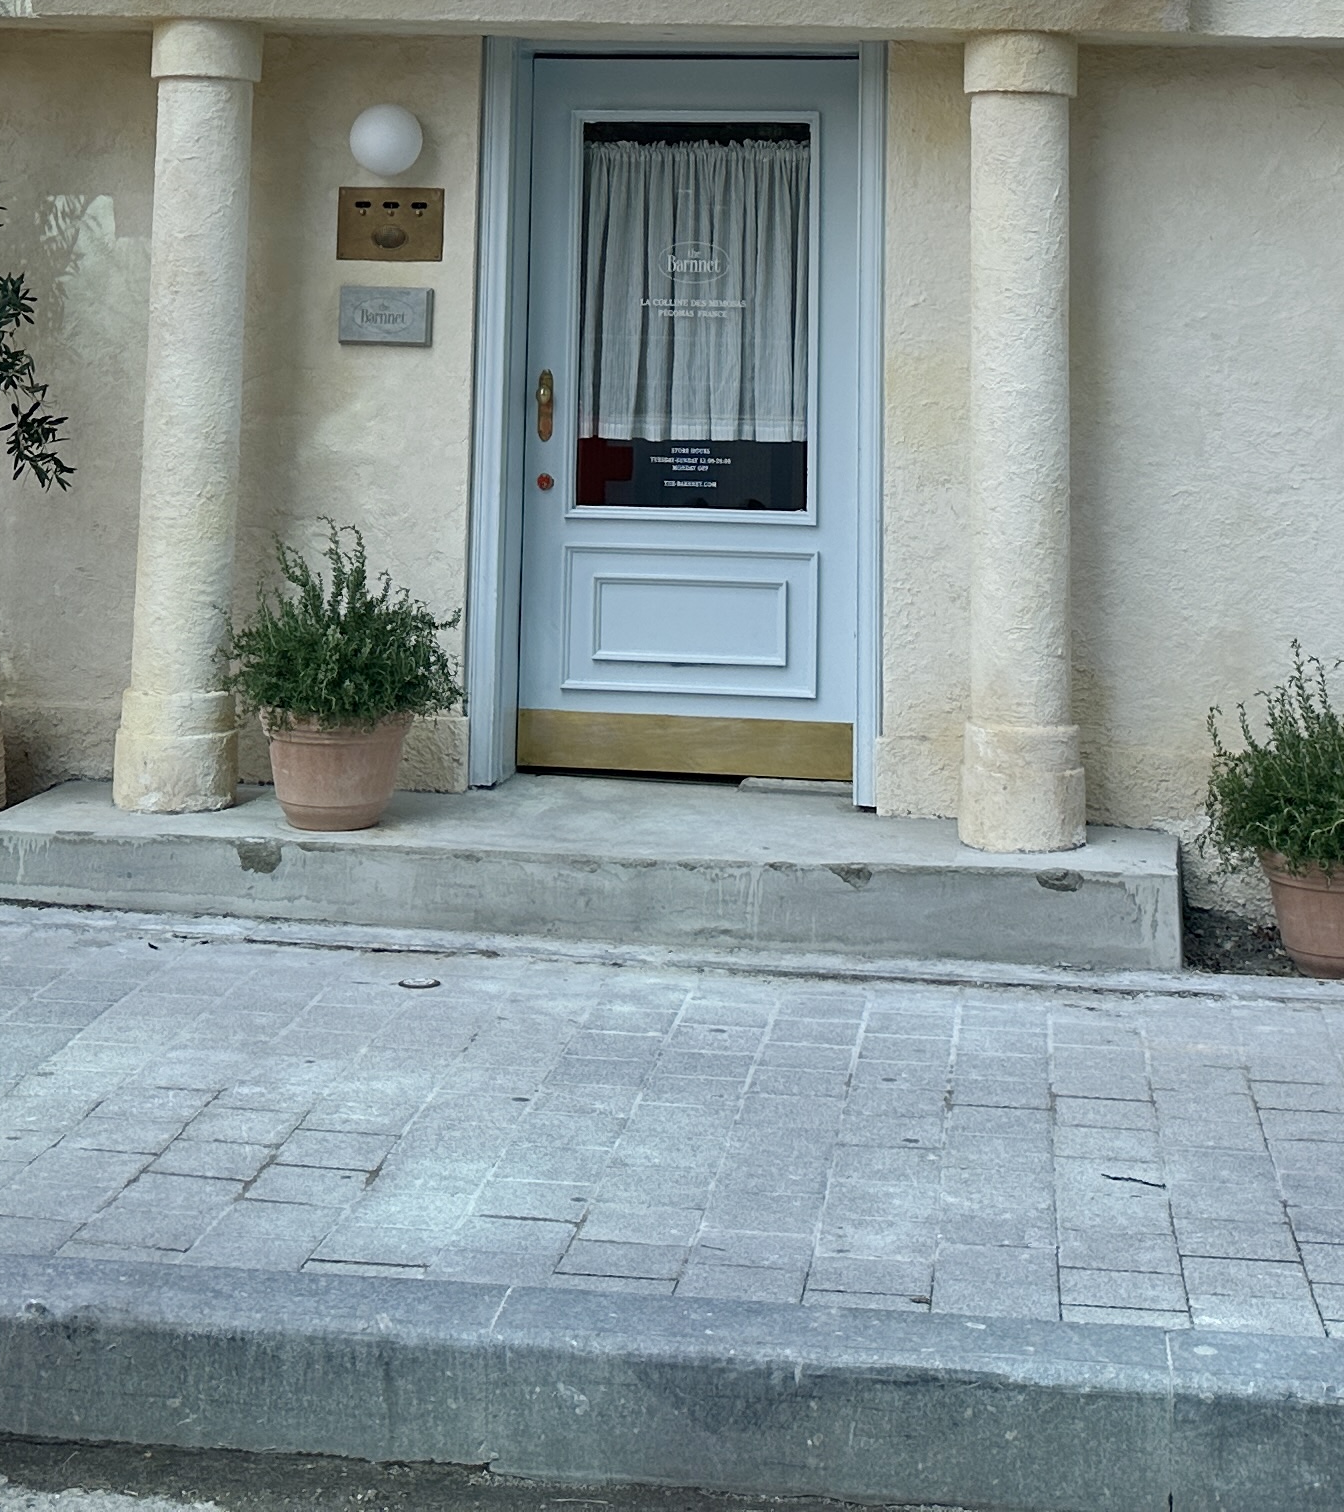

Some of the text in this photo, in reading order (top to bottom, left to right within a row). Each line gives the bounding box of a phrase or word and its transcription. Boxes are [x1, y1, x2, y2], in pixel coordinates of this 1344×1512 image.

[667, 254, 721, 273] Barnnet
[360, 308, 406, 325] Barnnet
[697, 310, 728, 318] FRANCE
